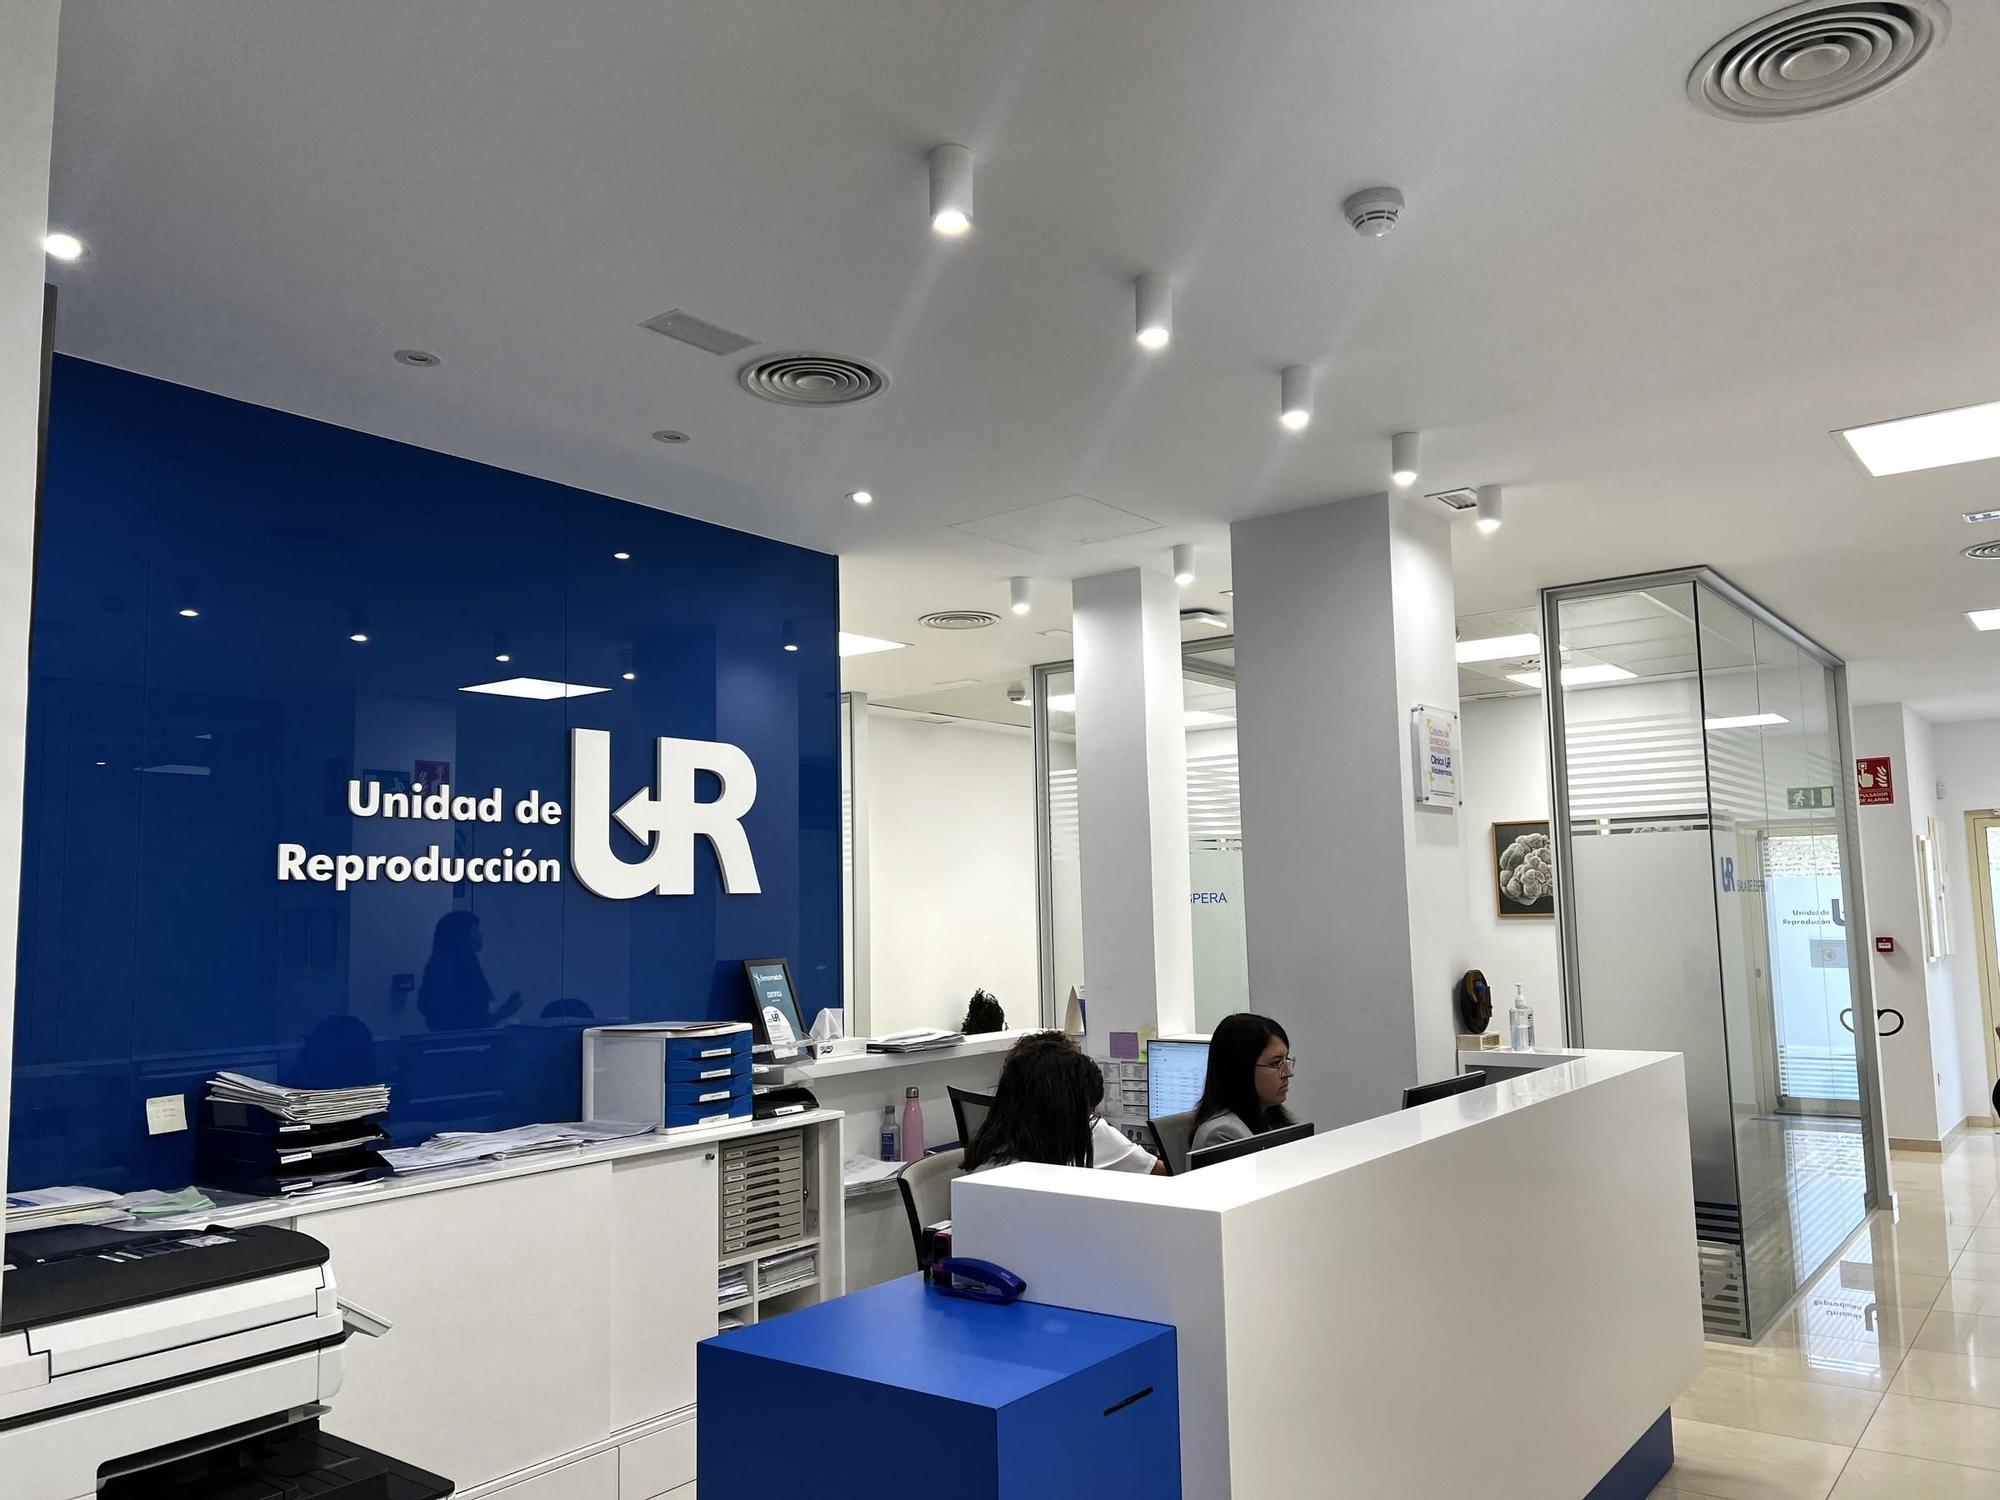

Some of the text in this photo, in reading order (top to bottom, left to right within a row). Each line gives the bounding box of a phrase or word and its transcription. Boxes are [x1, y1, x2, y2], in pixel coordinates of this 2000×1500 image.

[348, 780, 561, 825] Unidad de
[571, 728, 761, 900] UR
[277, 843, 560, 891] Reproducción
[1190, 892, 1228, 904] PERA
